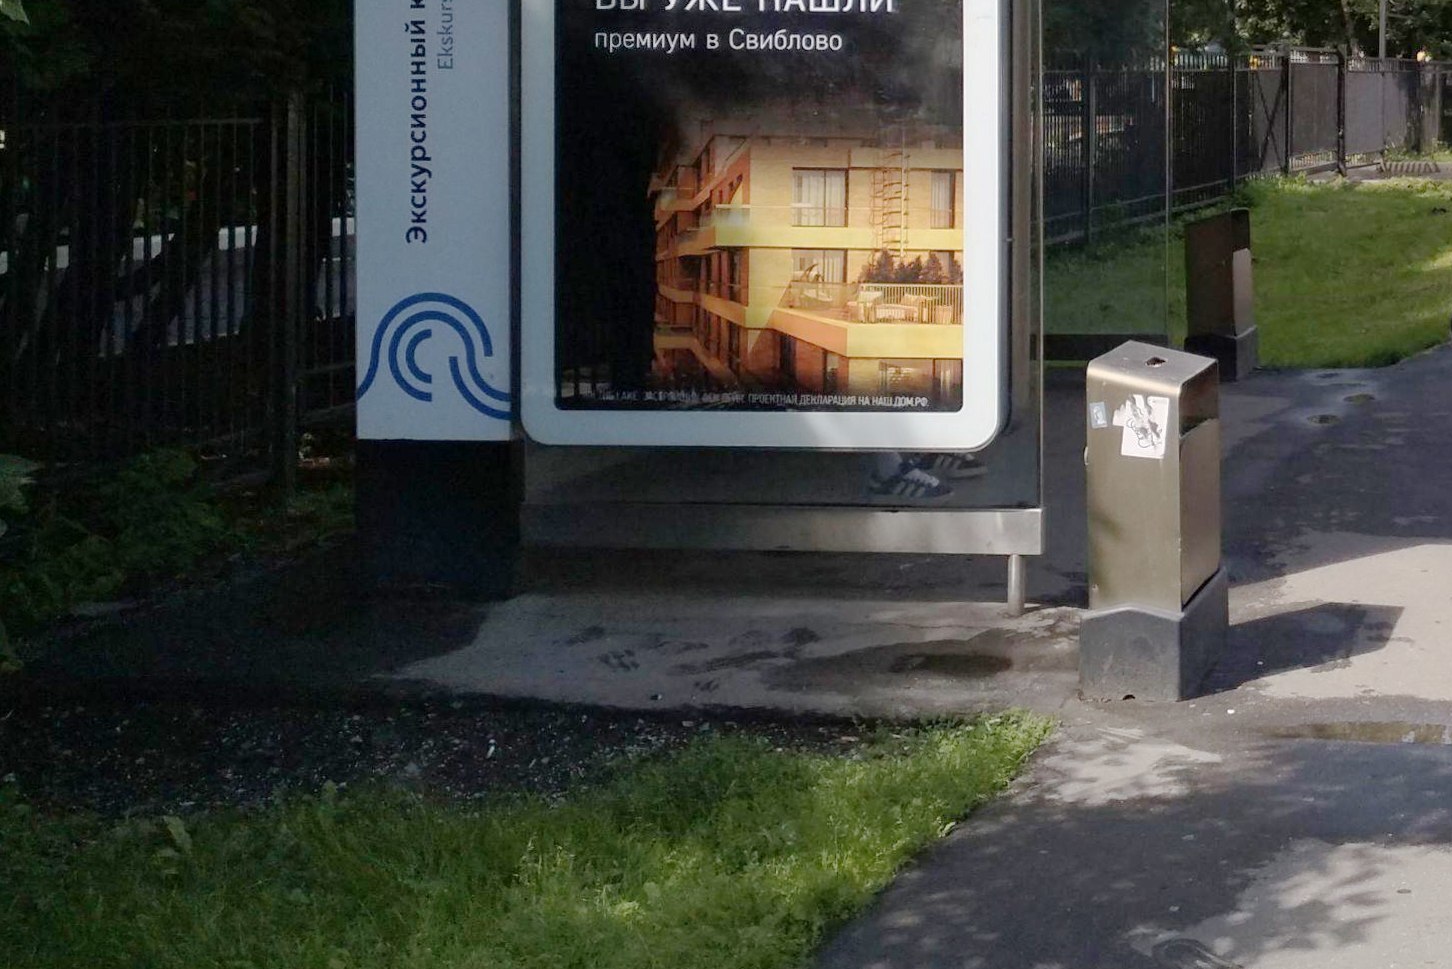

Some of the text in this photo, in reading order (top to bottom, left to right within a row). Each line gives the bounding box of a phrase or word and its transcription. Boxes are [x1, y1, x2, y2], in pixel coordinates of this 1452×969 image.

[594, 29, 843, 54] премиум в Свиблово
[405, 21, 432, 244] Экскурсионный
[858, 396, 870, 405] НА
